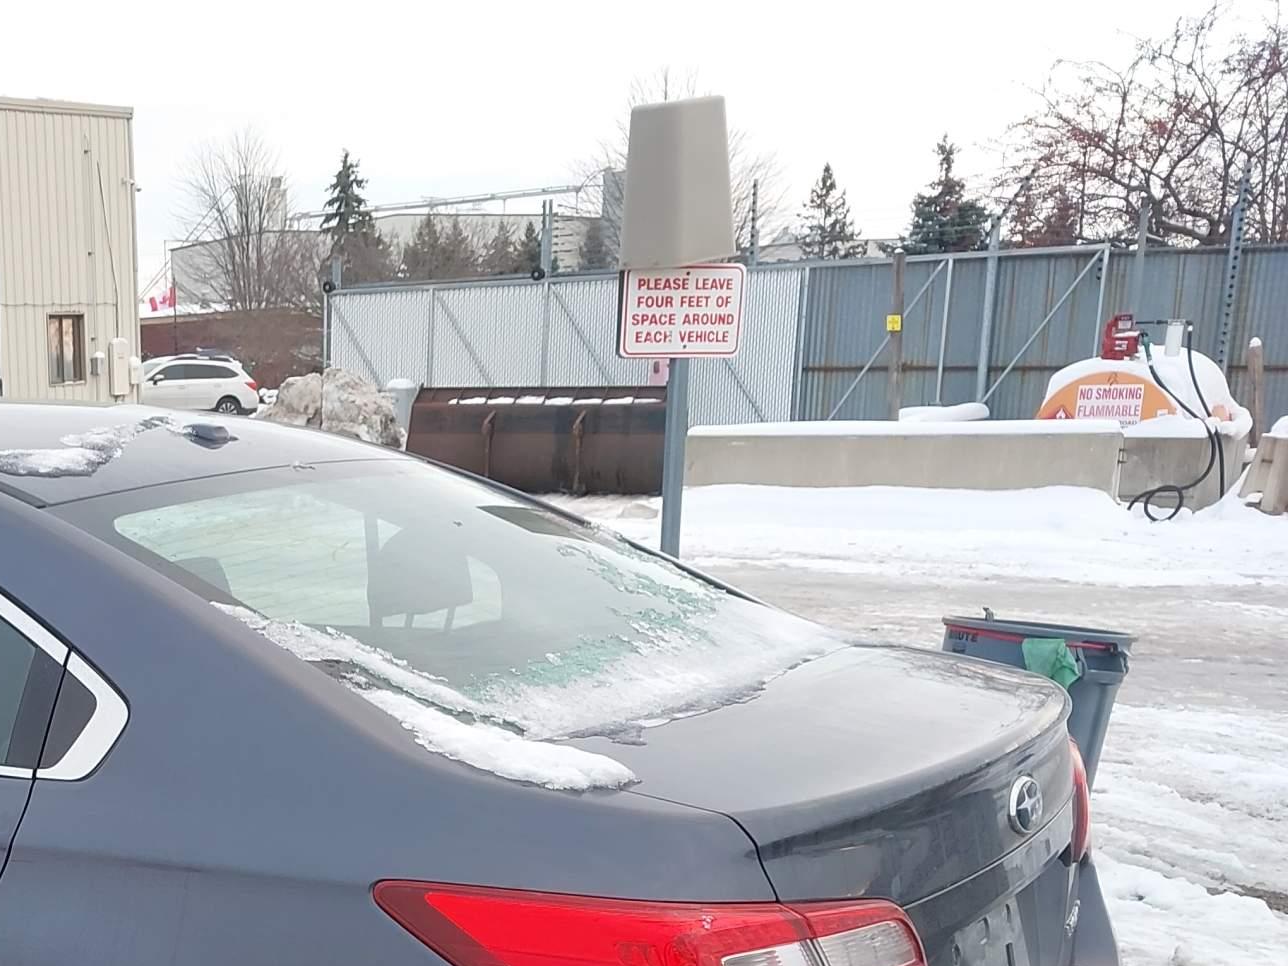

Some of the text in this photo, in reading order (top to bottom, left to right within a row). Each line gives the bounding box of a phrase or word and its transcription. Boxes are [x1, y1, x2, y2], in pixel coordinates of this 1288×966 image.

[637, 278, 733, 290] PLEASE LEAVE
[636, 296, 732, 308] FOUR FEET OF
[631, 313, 734, 326] SPACE AROUND
[635, 330, 729, 343] EACH VEHICLE
[1079, 387, 1143, 400] NO SMOKING
[1077, 404, 1141, 417] FLAMMABLE
